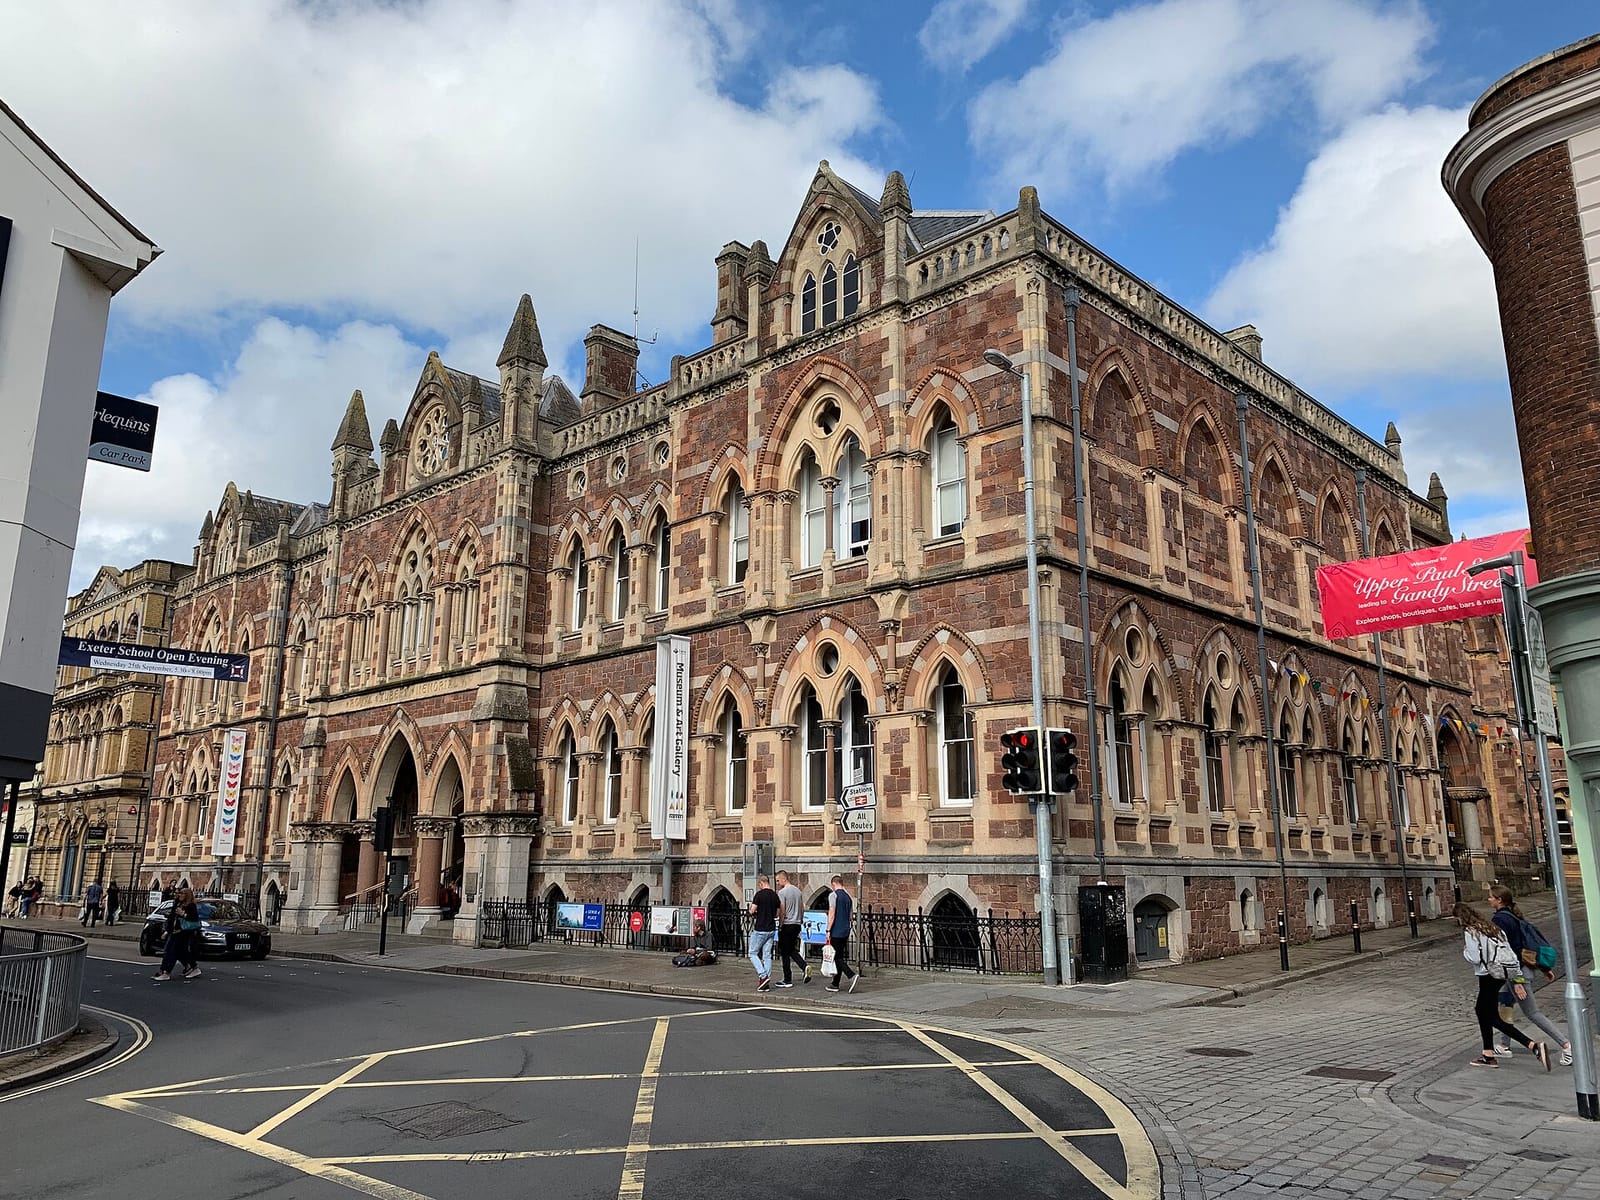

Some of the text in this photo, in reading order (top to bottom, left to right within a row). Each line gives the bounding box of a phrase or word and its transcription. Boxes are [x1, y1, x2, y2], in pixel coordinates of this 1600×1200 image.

[100, 447, 147, 464] Car Park
[1411, 558, 1439, 567] Welcome
[1353, 576, 1408, 600] Upper
[1412, 561, 1464, 584] Paul
[1391, 576, 1501, 604] Gandy Stree
[1355, 617, 1380, 625] Explore
[1380, 613, 1402, 621] shops,
[1402, 607, 1438, 617] boutiques,
[1438, 603, 1459, 612] cafes,
[1483, 597, 1503, 605] resta
[1358, 600, 1380, 609] leading
[77, 641, 229, 668] Exeter School Open Evening
[93, 659, 126, 669] Wednesday
[676, 662, 684, 706] Museum
[676, 708, 684, 717] &
[672, 739, 683, 777] Gallery
[850, 786, 873, 795] Stations
